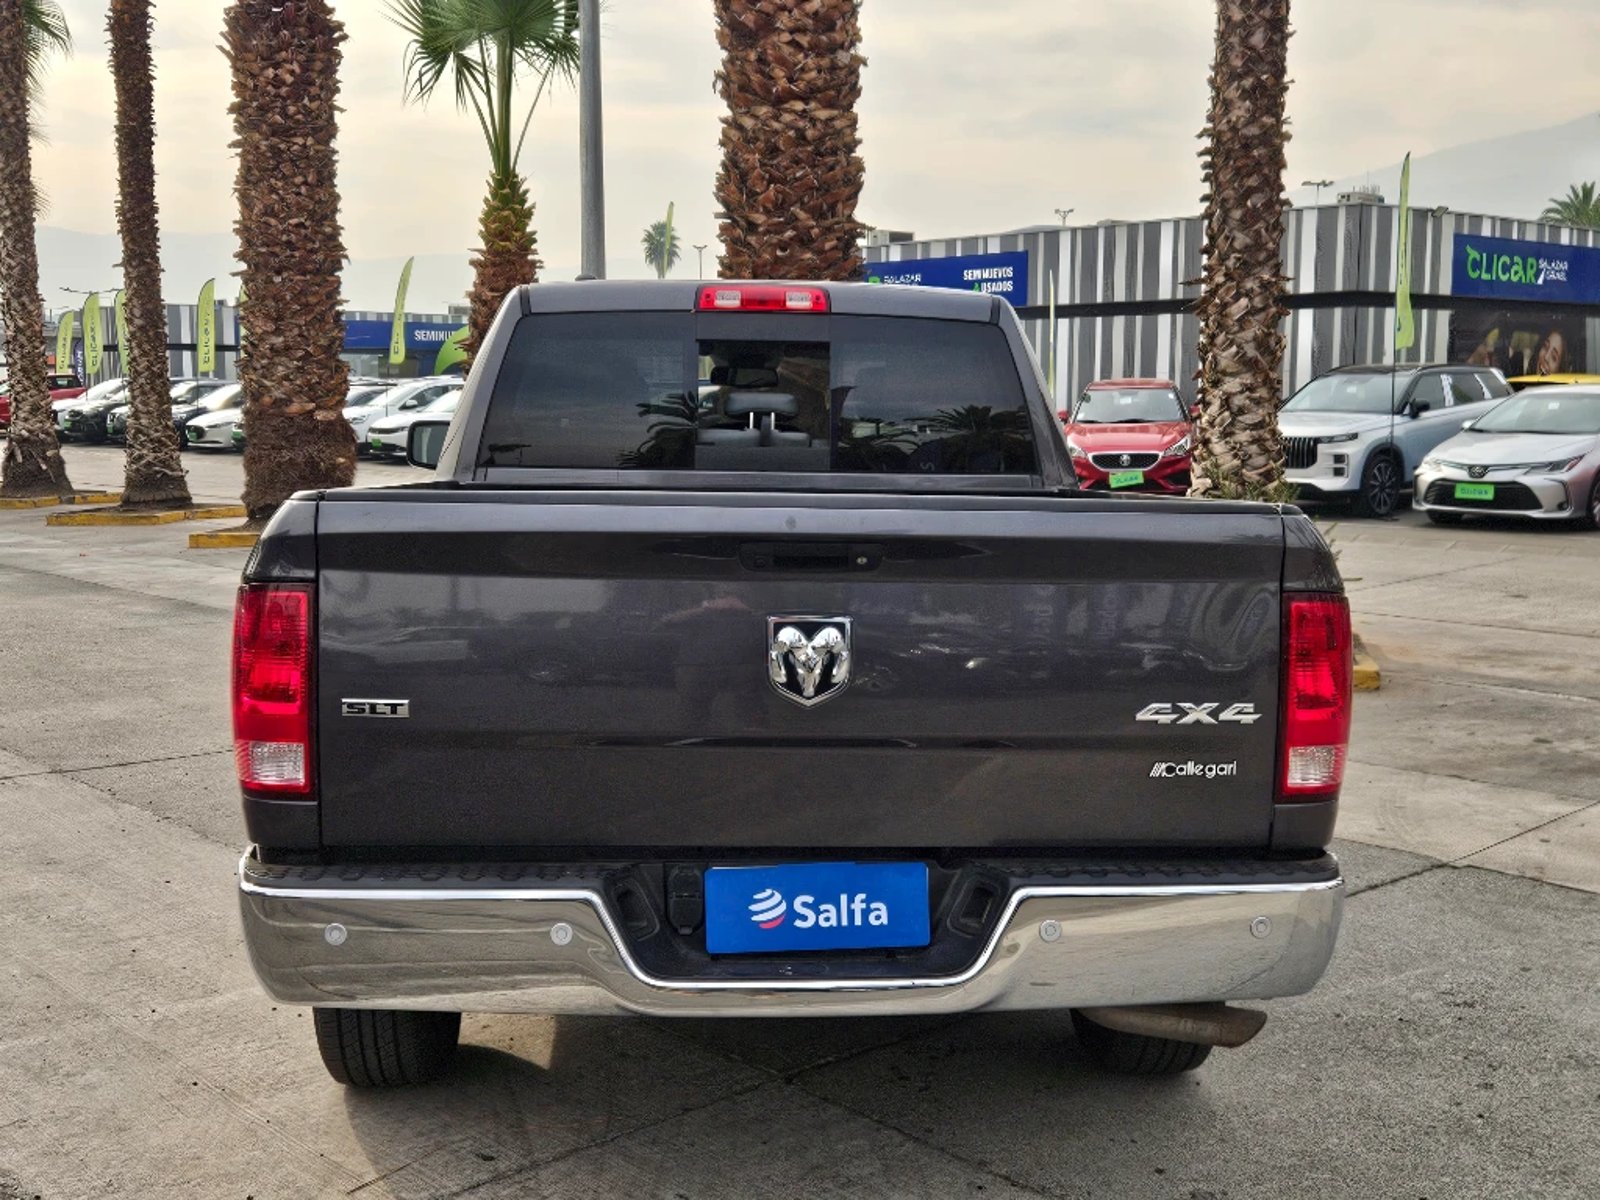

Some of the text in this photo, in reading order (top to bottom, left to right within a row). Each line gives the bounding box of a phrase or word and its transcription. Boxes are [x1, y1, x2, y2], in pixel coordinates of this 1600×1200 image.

[963, 266, 1014, 281] SEMINUEVOS
[981, 280, 1014, 293] USADOS
[344, 701, 407, 716] SLT
[1135, 702, 1263, 725] 4X4
[1160, 760, 1237, 779] Callegari
[792, 892, 889, 929] Salfa
